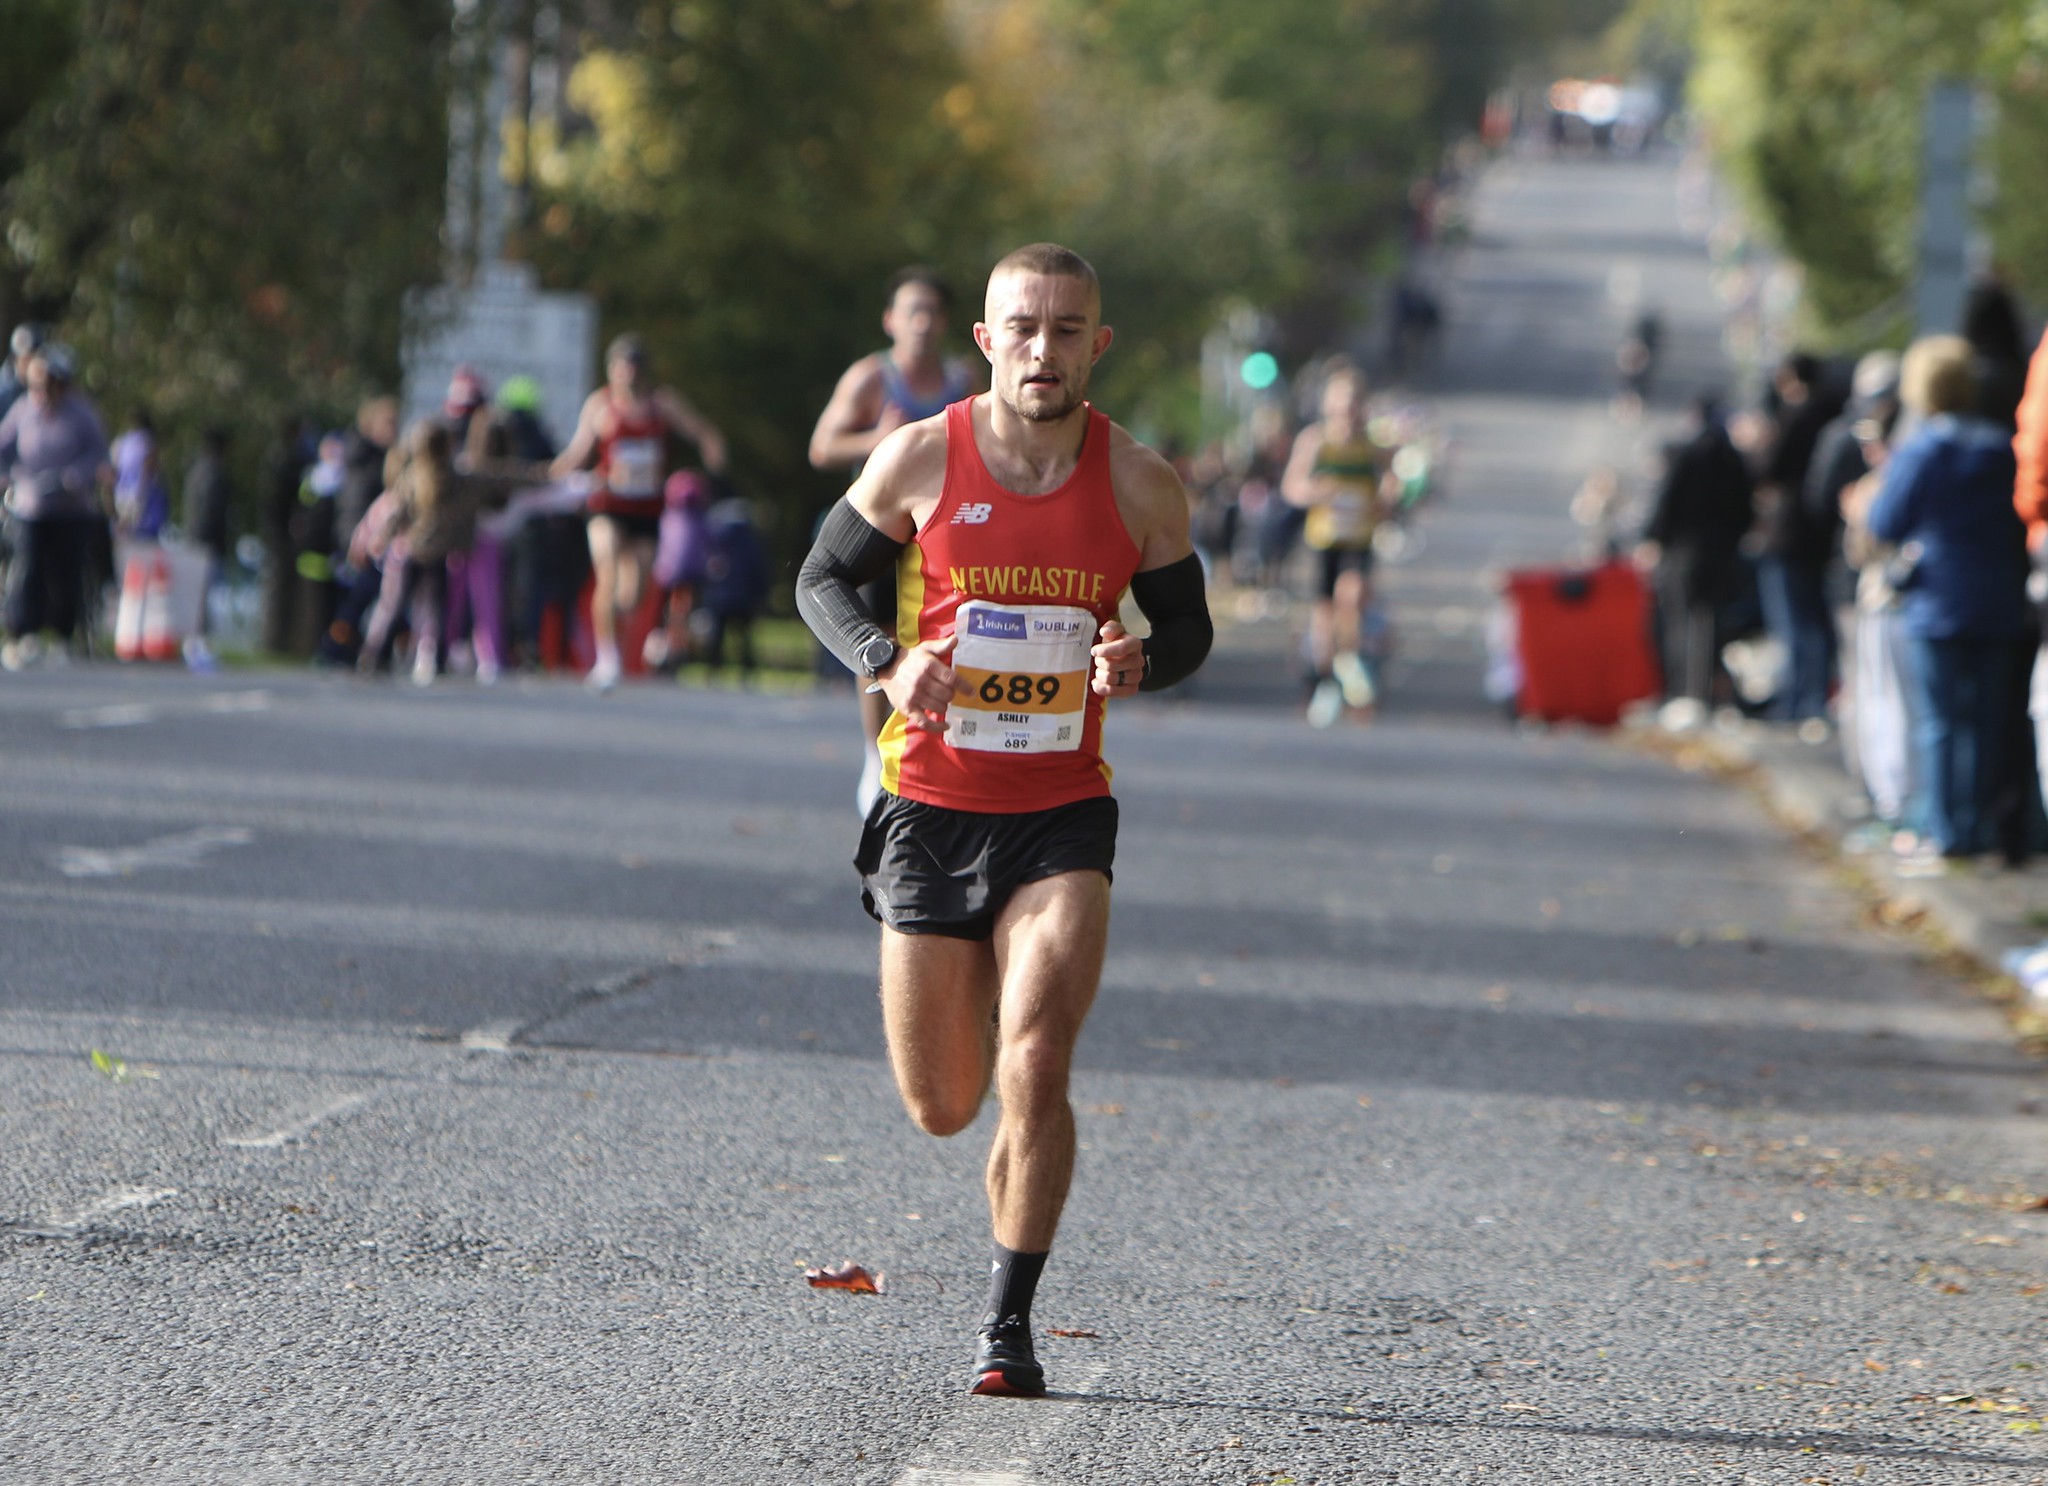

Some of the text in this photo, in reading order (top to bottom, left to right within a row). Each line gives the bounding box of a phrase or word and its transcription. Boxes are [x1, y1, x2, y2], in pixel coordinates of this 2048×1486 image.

[951, 502, 992, 524] NB
[949, 566, 1105, 602] NEWCASTLE
[985, 620, 1003, 631] Irish
[1004, 621, 1020, 631] Life
[1034, 621, 1080, 632] DUBLIN
[980, 674, 1060, 705] 689
[998, 713, 1030, 723] ASHLEY
[1005, 739, 1028, 749] 689
